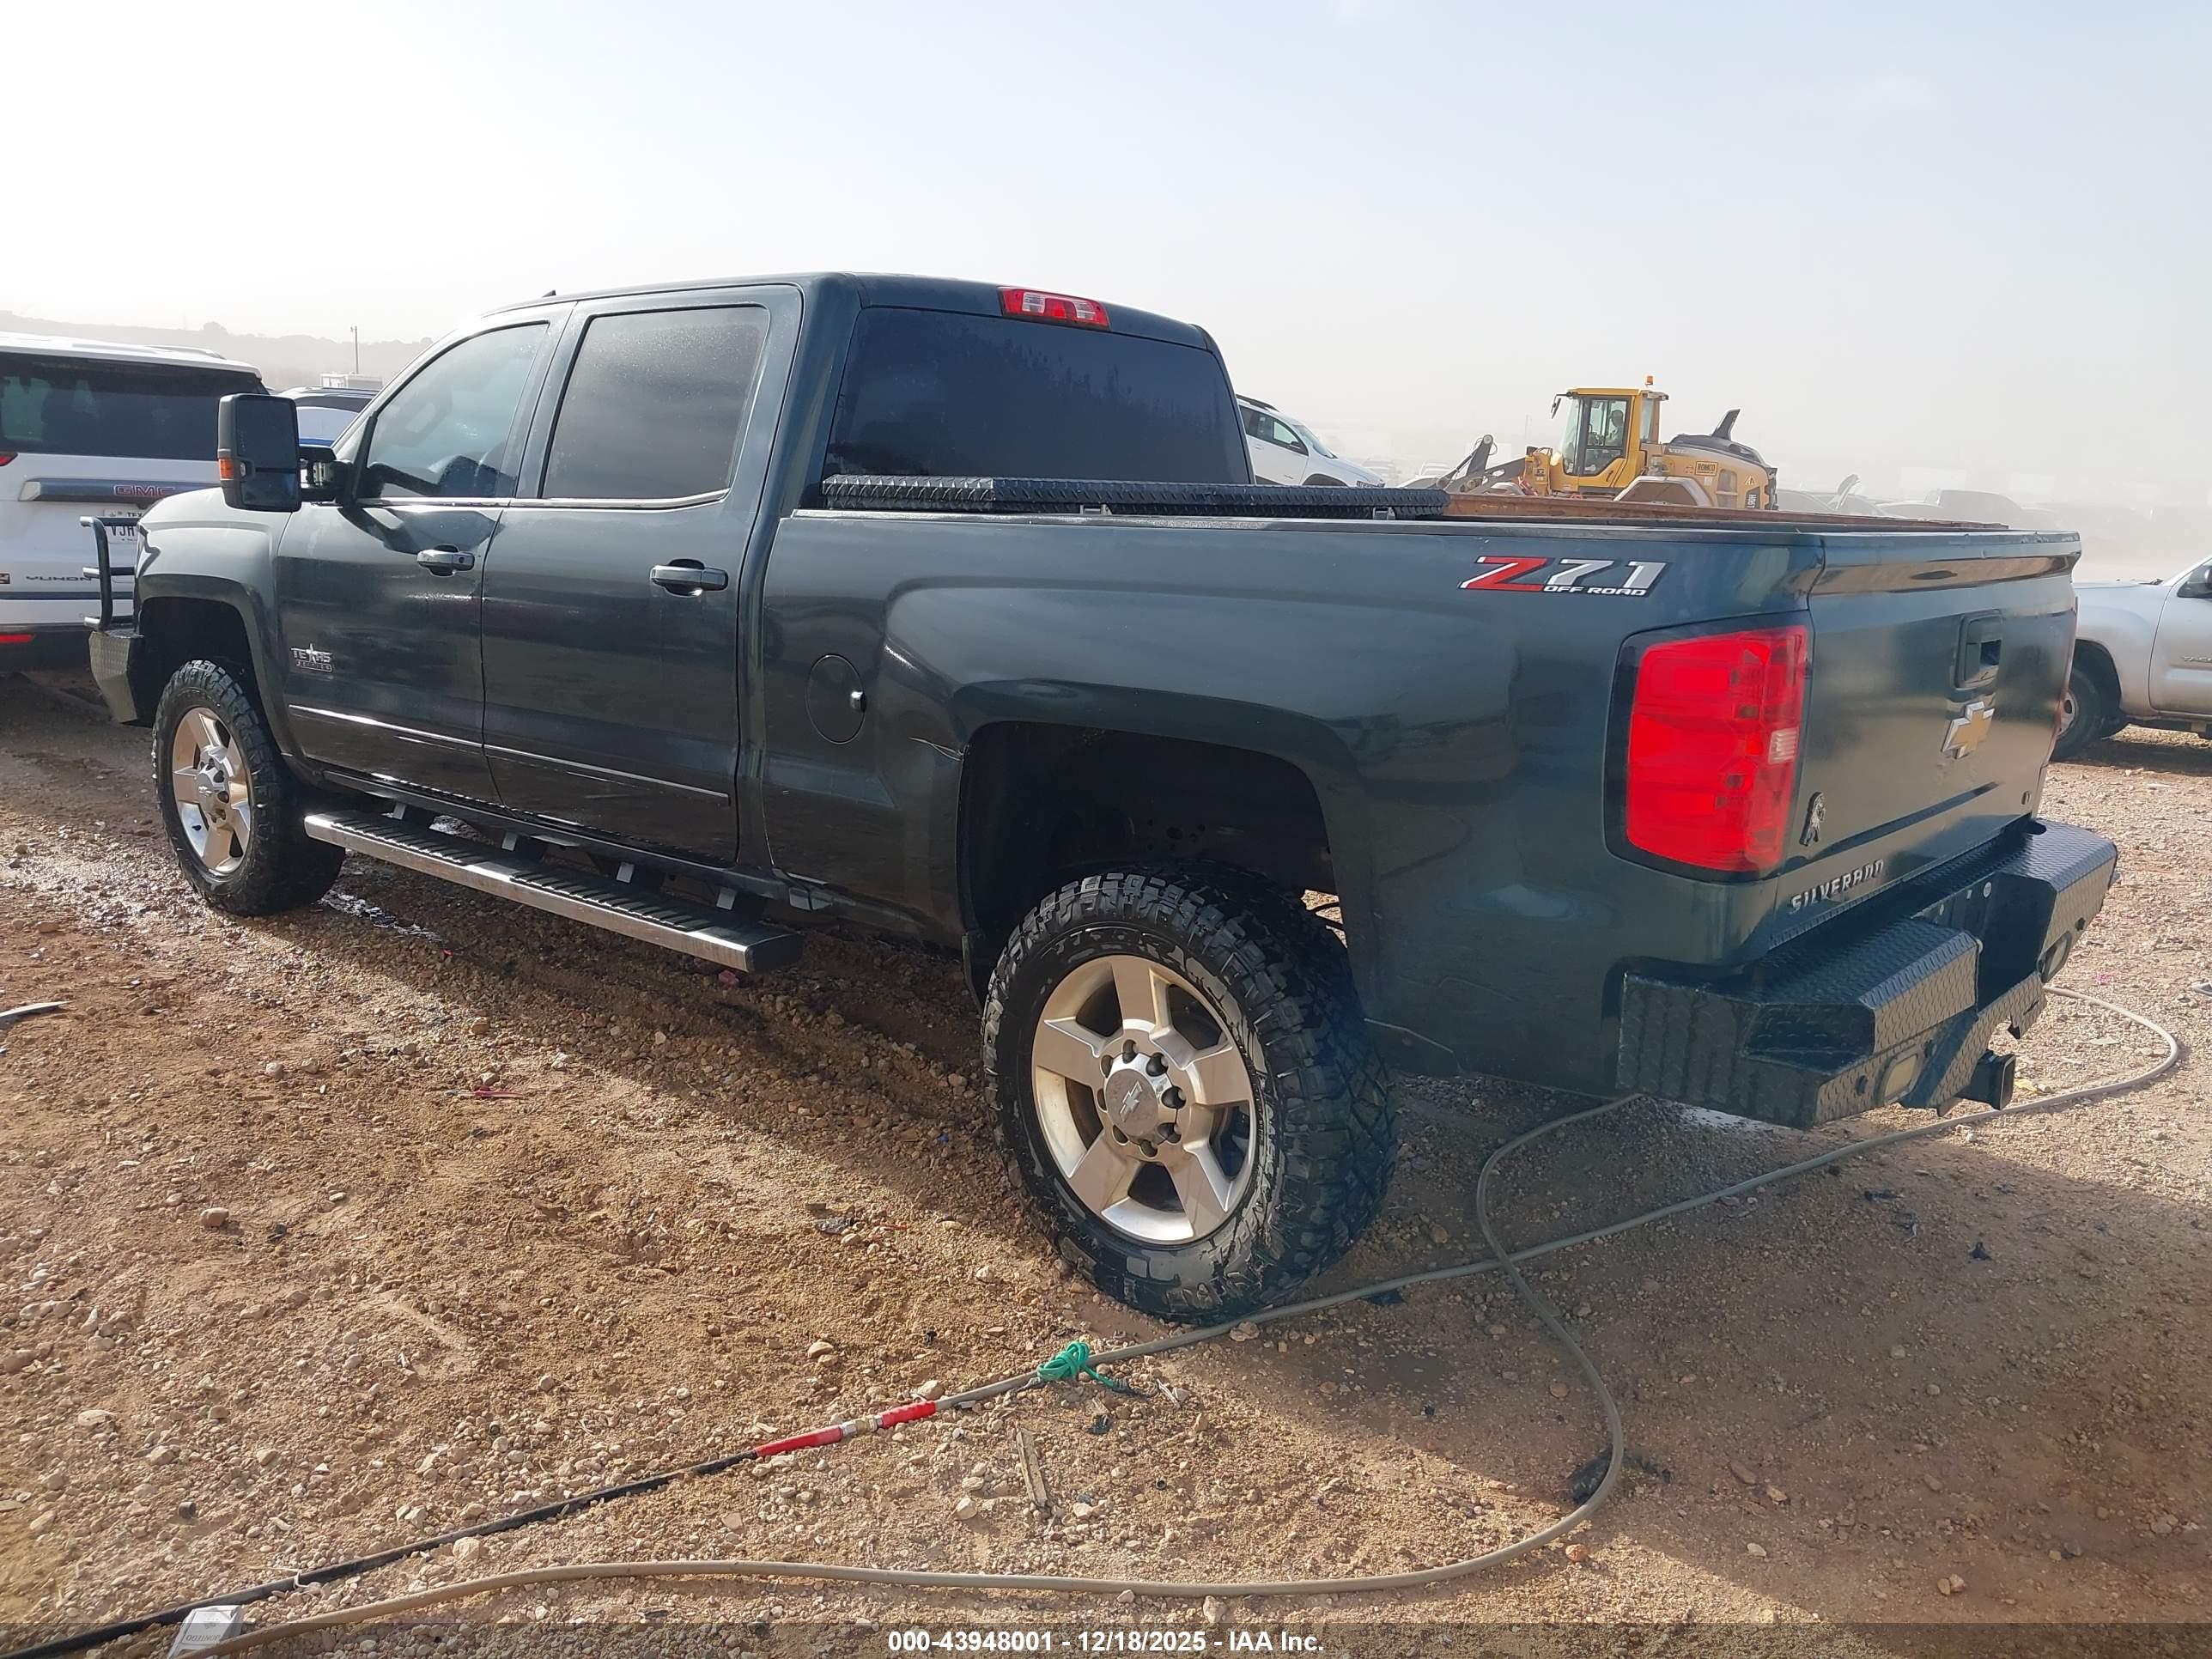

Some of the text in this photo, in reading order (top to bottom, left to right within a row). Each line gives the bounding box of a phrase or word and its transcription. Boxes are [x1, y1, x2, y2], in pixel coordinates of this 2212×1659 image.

[113, 484, 175, 495] GMC
[1460, 556, 1667, 592] Z71
[1587, 587, 1647, 597] ROAD
[291, 645, 331, 663] TEXAS
[1789, 859, 1884, 915] SILVERADO
